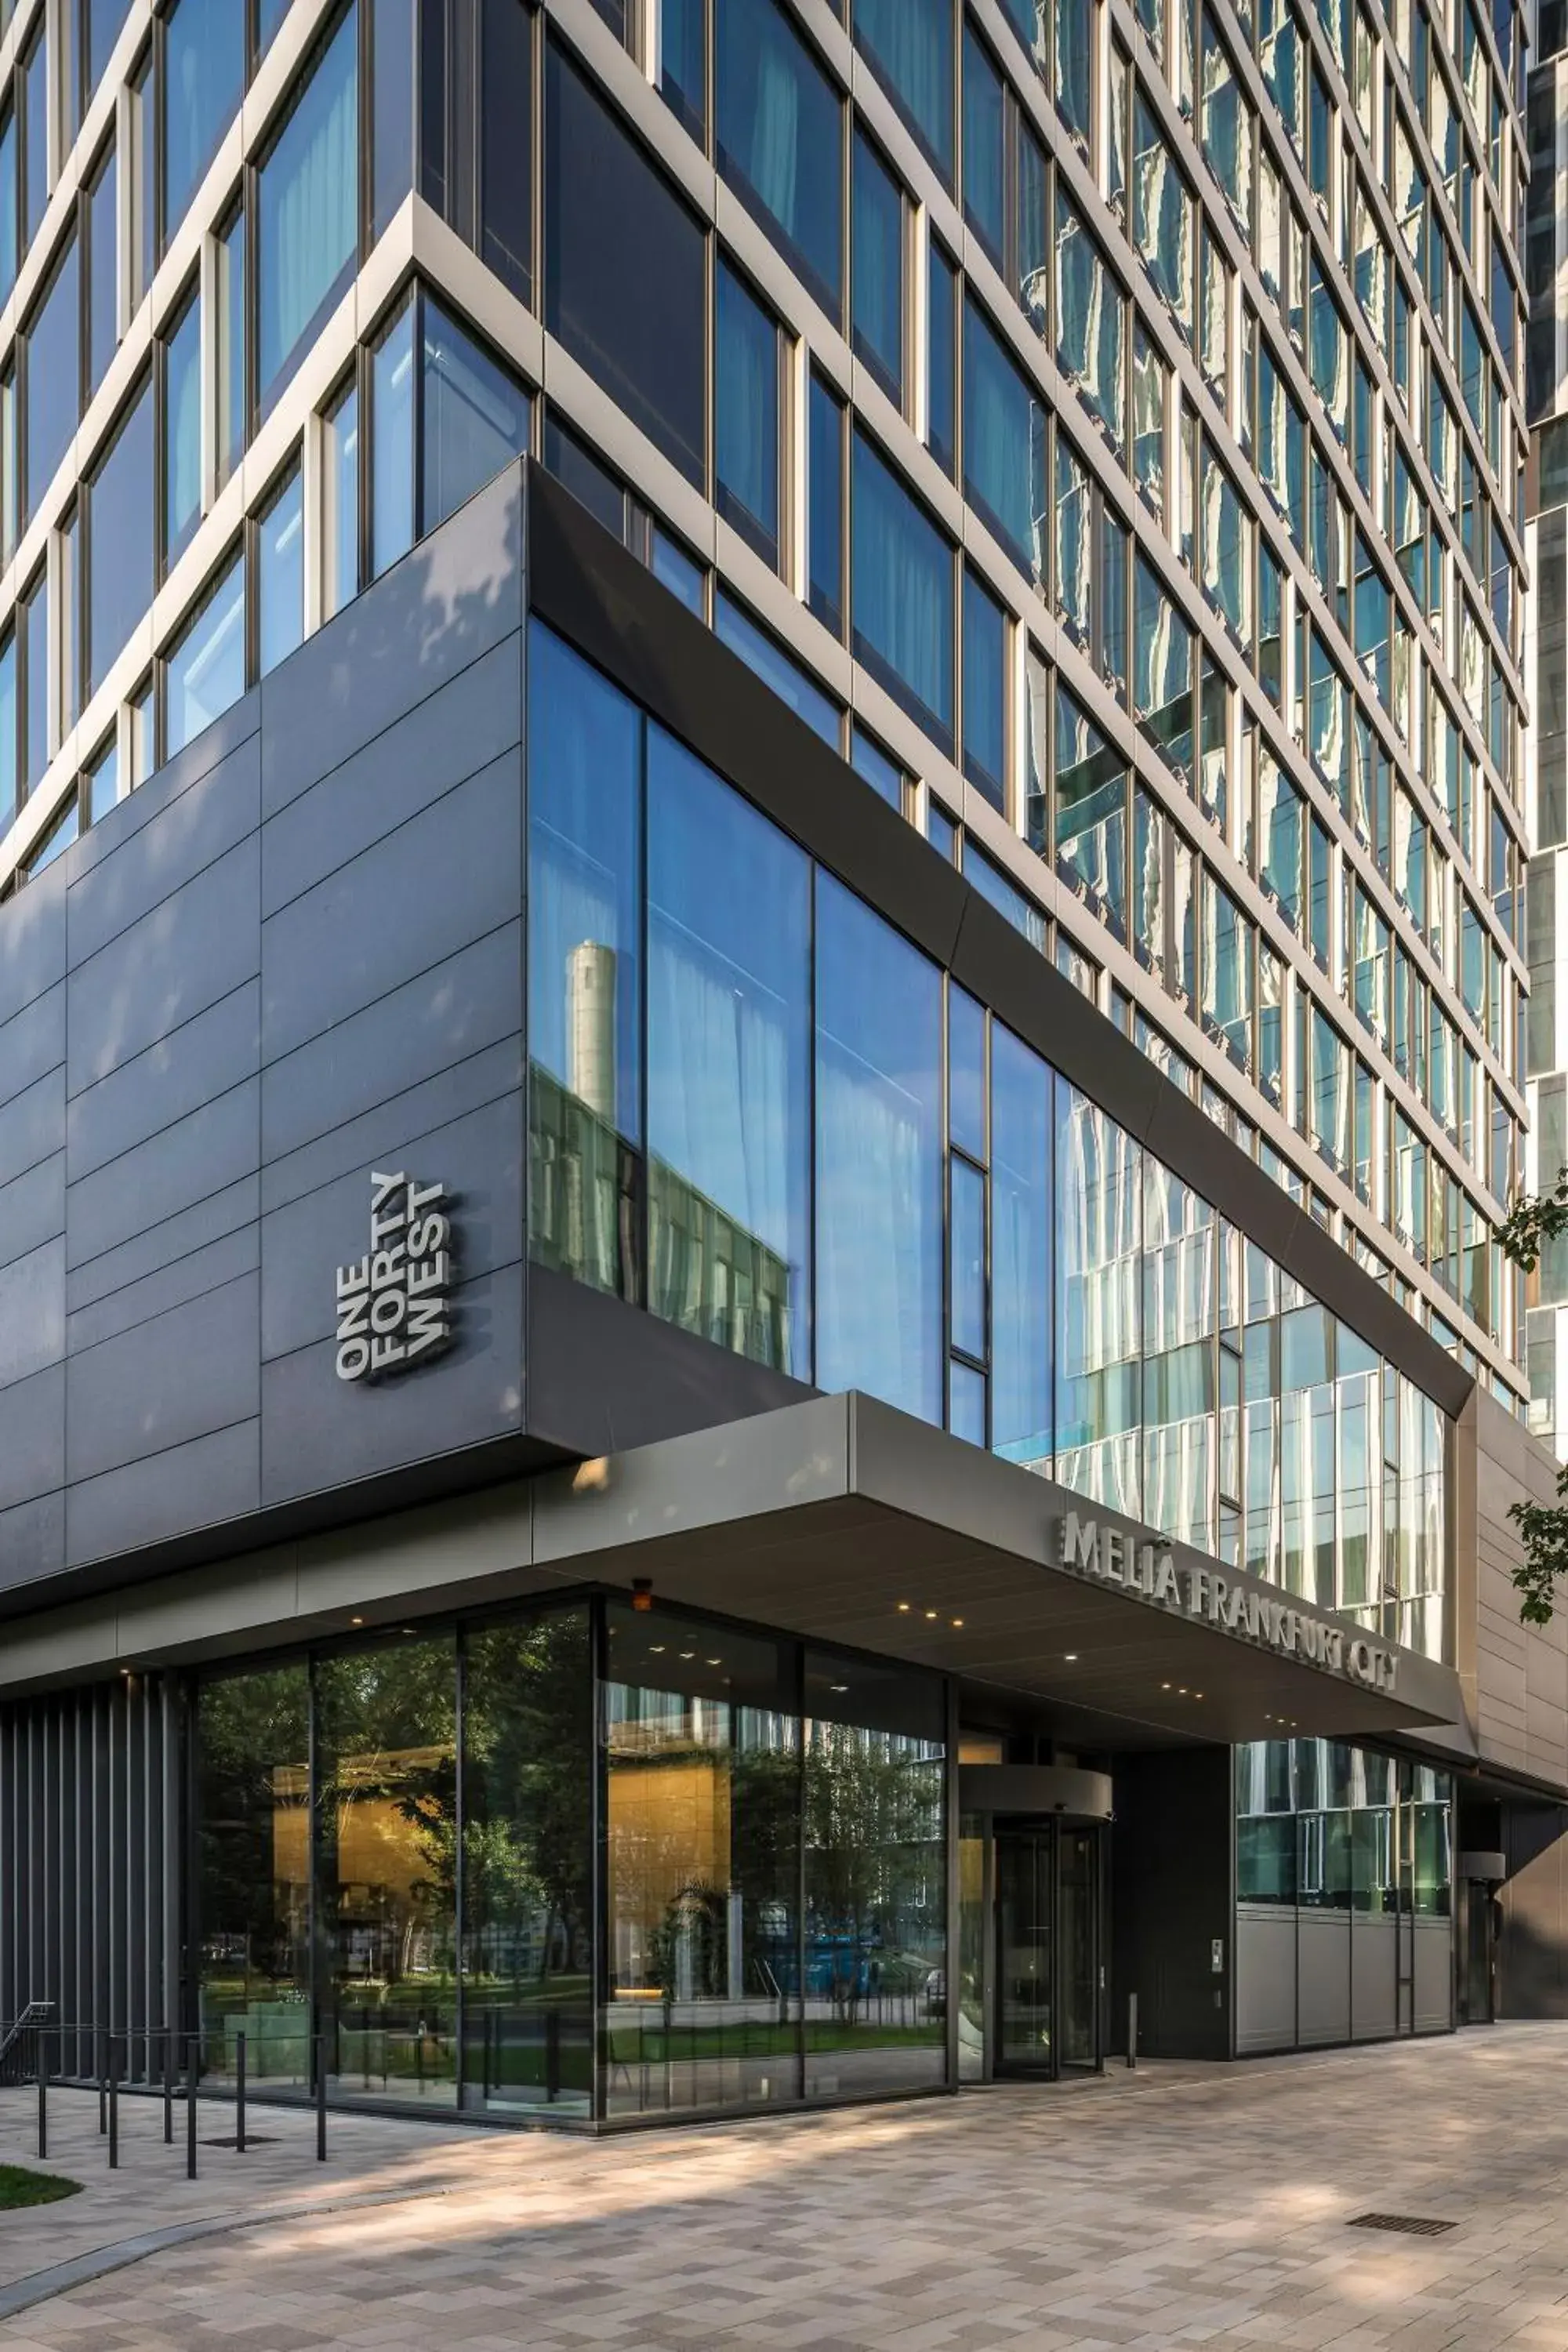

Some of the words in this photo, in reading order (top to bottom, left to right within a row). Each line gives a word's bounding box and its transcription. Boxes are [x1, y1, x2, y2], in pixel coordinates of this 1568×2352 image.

[336, 1254, 371, 1381] ONE
[371, 1171, 407, 1371] FORTY
[407, 1181, 448, 1359] WEST
[1190, 1566, 1345, 1670] FRANKFURT
[1348, 1639, 1399, 1691] CITY
